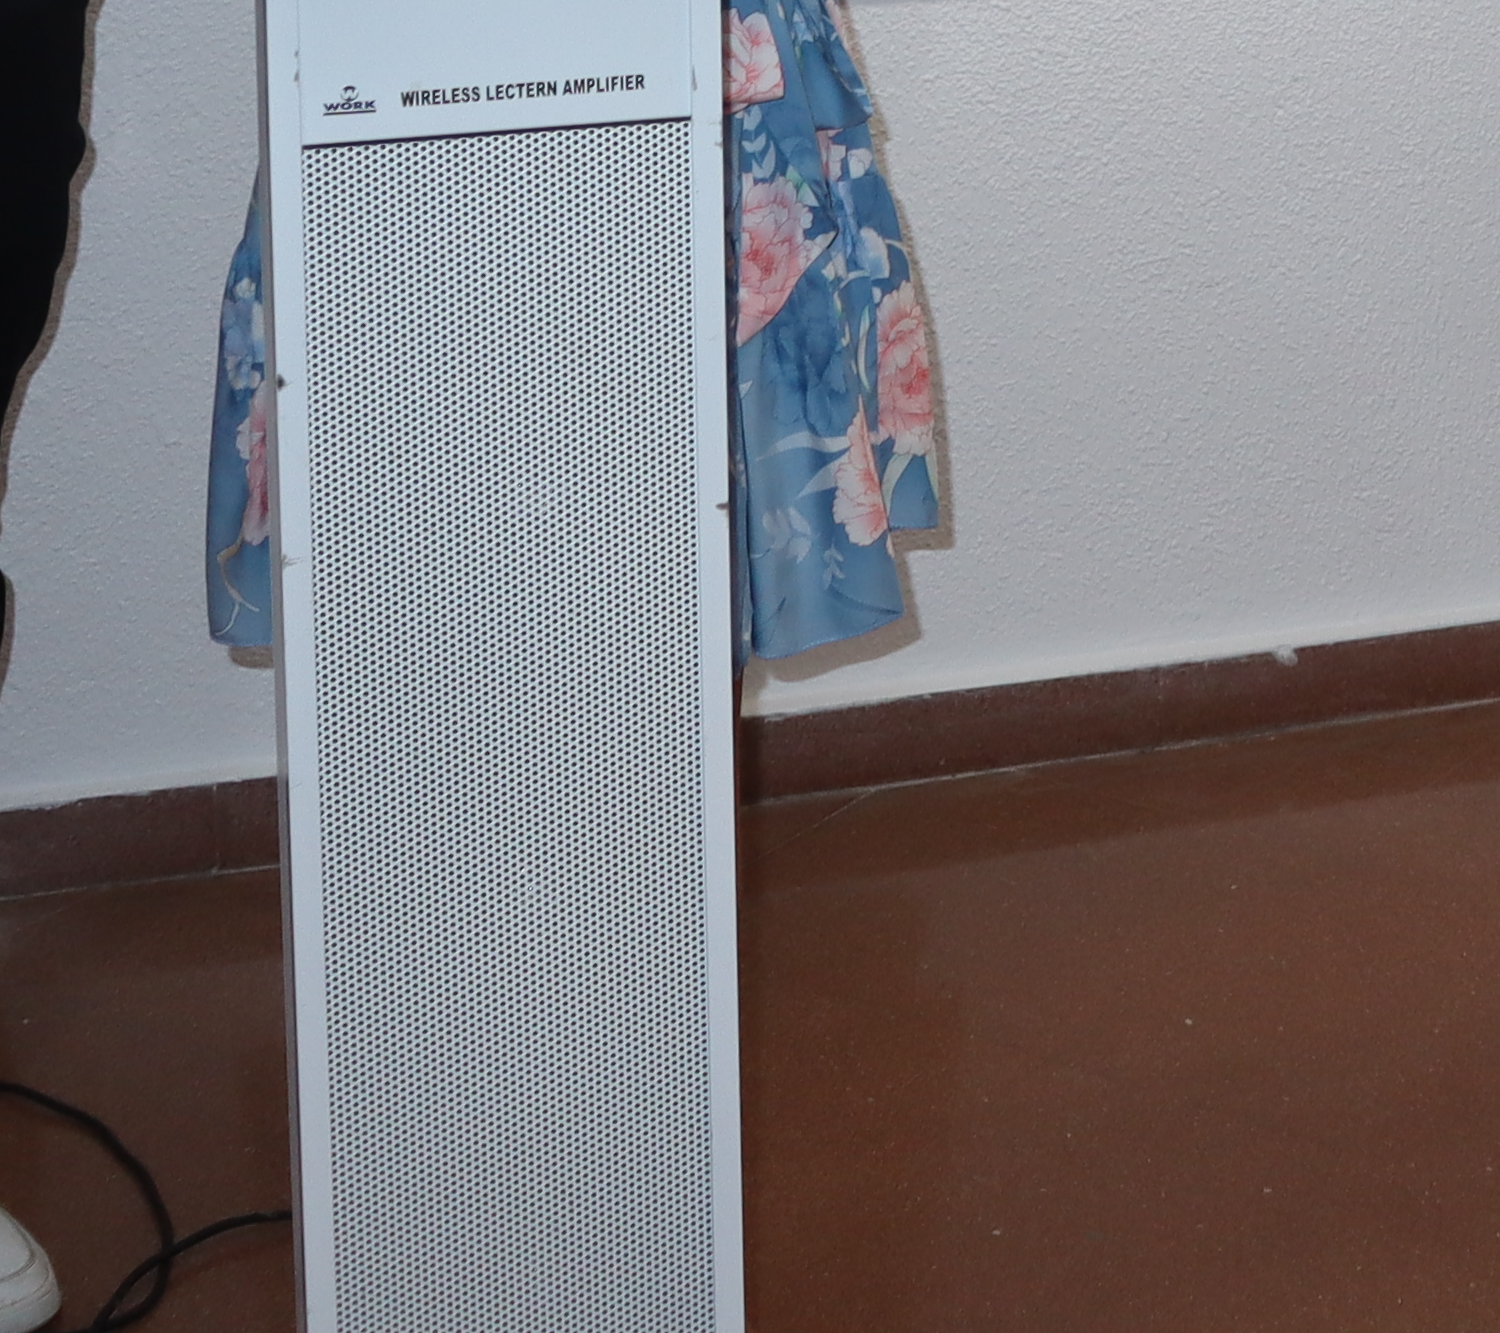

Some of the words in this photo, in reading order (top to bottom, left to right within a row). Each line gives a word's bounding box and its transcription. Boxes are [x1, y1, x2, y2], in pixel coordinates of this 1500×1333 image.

[400, 86, 481, 108] WIRELESS
[486, 80, 557, 102] LECTERN
[562, 74, 646, 96] AMPLIFIER
[323, 100, 376, 112] WORK
